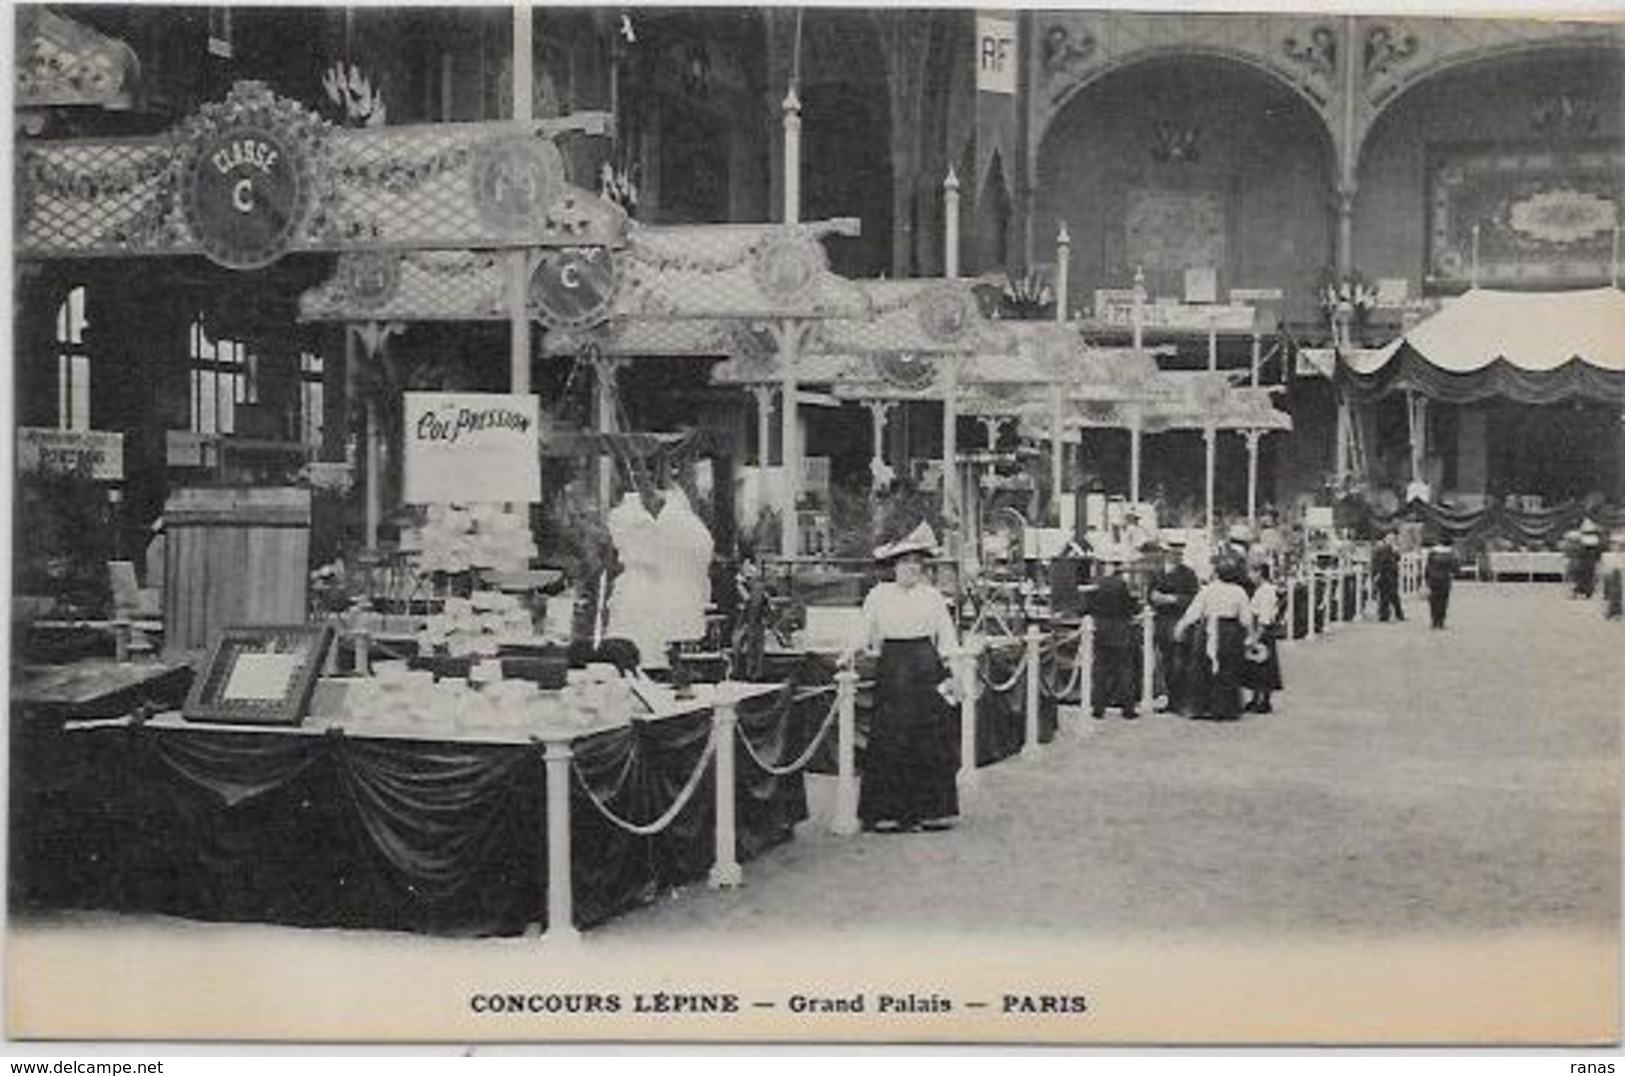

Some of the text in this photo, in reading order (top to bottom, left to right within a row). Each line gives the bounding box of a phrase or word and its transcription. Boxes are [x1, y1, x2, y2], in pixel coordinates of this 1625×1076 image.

[212, 140, 279, 174] CLASSE
[233, 179, 254, 212] C
[561, 263, 580, 288] C
